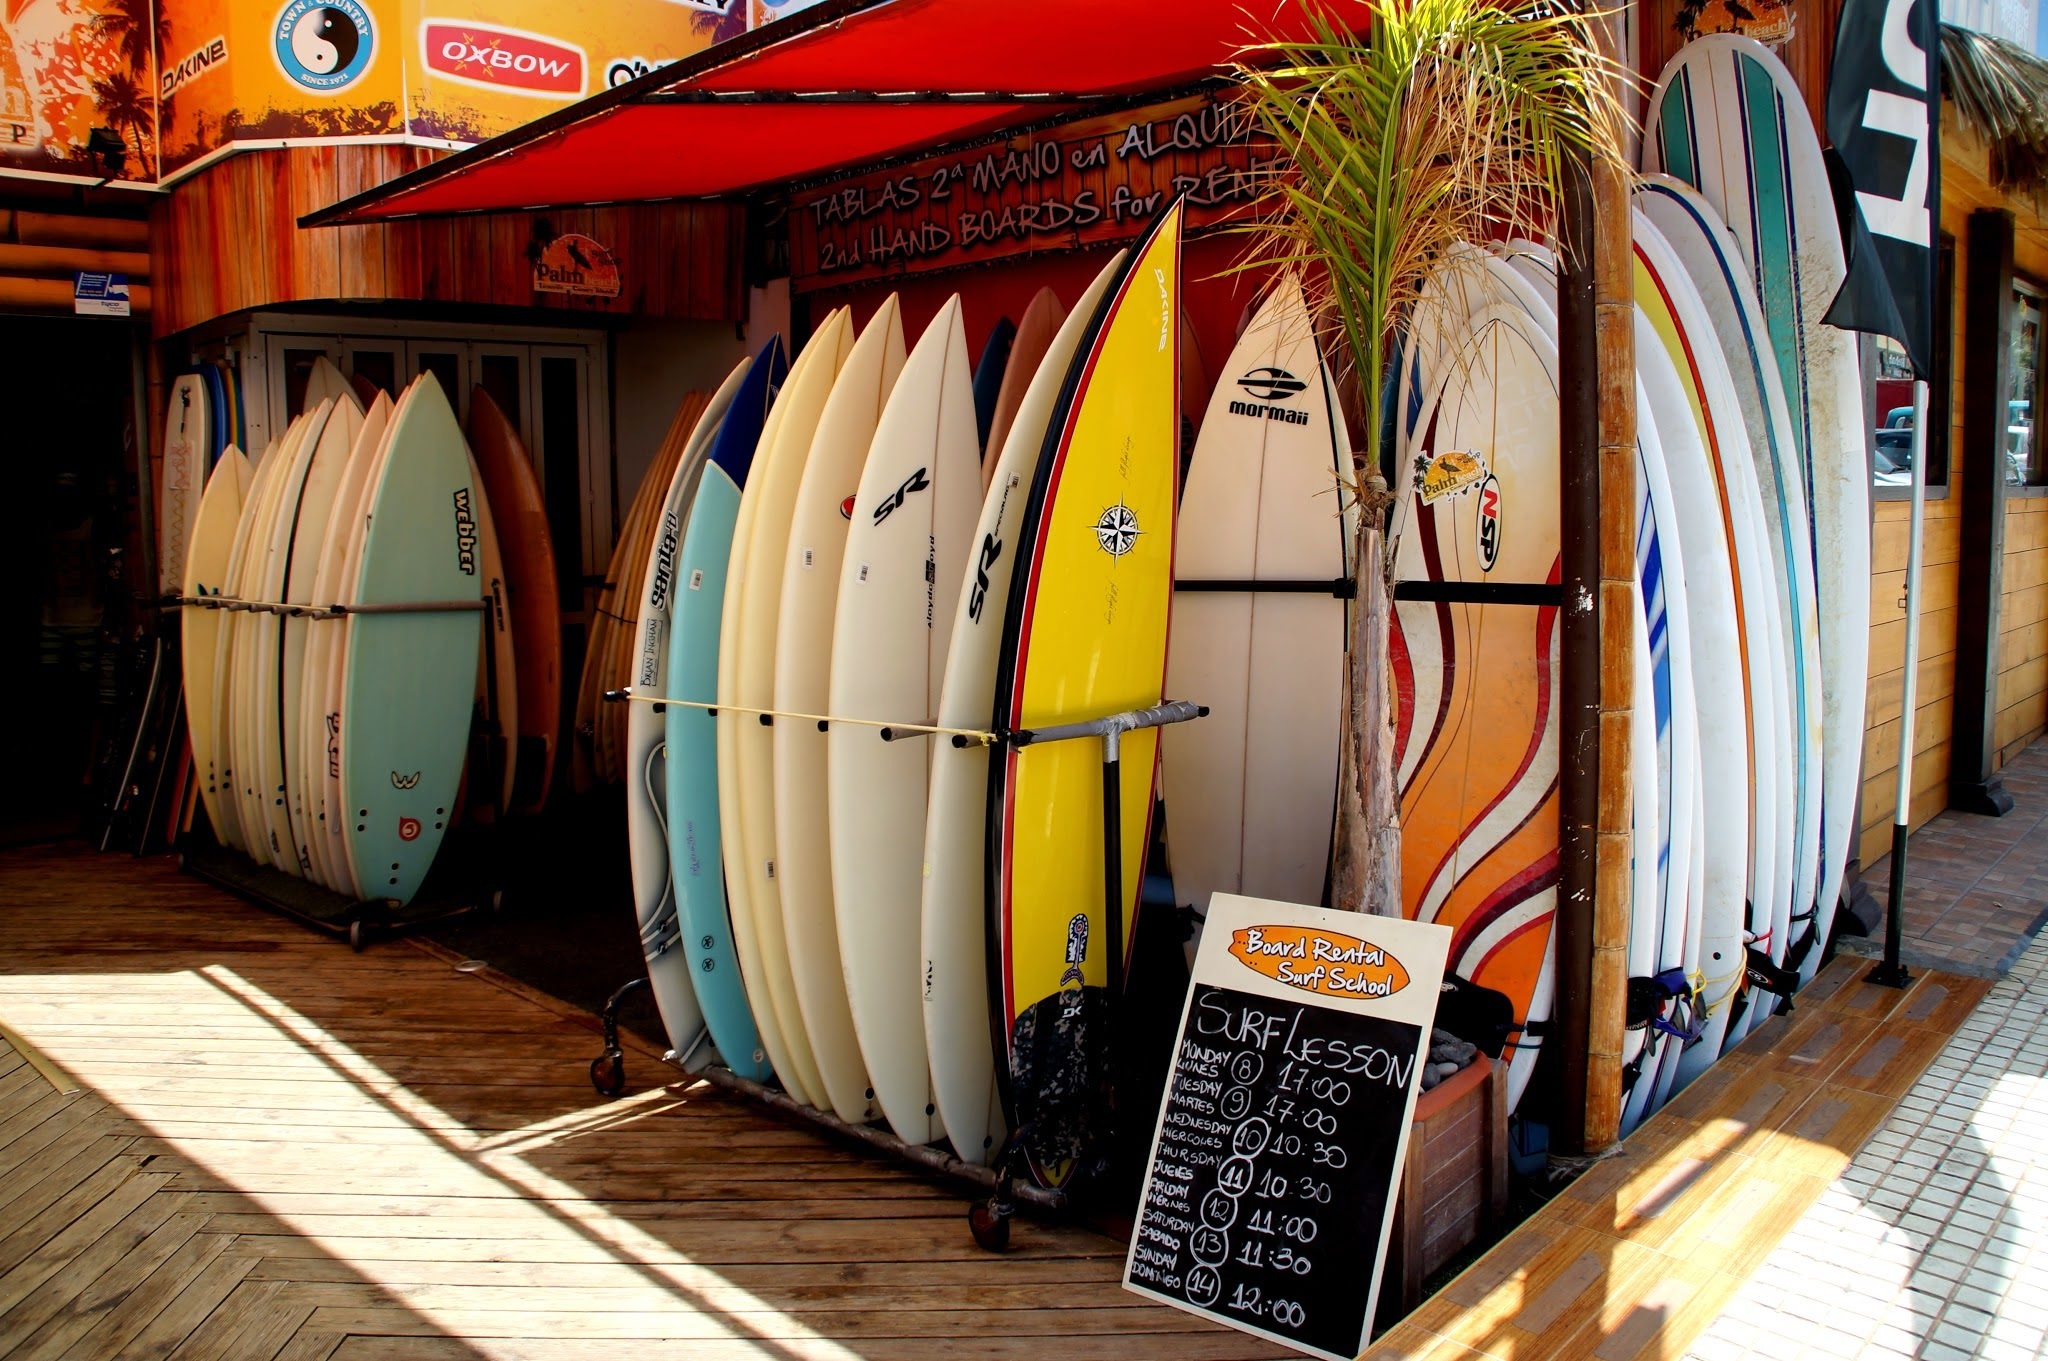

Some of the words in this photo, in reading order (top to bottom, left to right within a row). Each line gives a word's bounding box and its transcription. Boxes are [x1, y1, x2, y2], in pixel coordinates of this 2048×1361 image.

[279, 1, 307, 40] TOWN
[162, 39, 226, 95] DAKINE
[301, 73, 329, 86] SINCE
[330, 73, 349, 85] 1971
[442, 41, 571, 78] OXBOW
[809, 177, 920, 226] TABLAS
[972, 141, 1060, 193] MANO
[1071, 143, 1106, 168] en
[821, 238, 861, 270] 2nd
[869, 220, 951, 263] HAND
[958, 191, 1101, 246] BOARDS
[1111, 185, 1162, 222] for
[1154, 268, 1169, 352] DAKINE
[1229, 399, 1309, 427] mormaii
[1423, 476, 1458, 497] Palm
[453, 487, 476, 576] webber
[1480, 489, 1498, 563] NSP
[1246, 929, 1306, 958] Board
[1312, 937, 1385, 966] Rental
[1277, 961, 1325, 989] Surf
[1328, 967, 1393, 996] School
[1197, 991, 1286, 1050] SURF
[1283, 1008, 1414, 1089] LESSON
[1177, 1058, 1219, 1078] LUNES
[1182, 1039, 1231, 1067] MONDAY
[1278, 1061, 1351, 1106] 17:00
[1168, 1092, 1215, 1114] MARTES
[1172, 1073, 1224, 1100] TUESDAY
[1229, 1091, 1244, 1113] 9
[1263, 1094, 1337, 1135] 17:00
[1160, 1127, 1223, 1149] MIERCOLES
[1164, 1113, 1232, 1136] WEDNESDAY
[1234, 1127, 1262, 1150] 10
[1269, 1132, 1347, 1169] 10:30
[1153, 1159, 1194, 1181] JUEVES
[1157, 1141, 1224, 1169] THURSDAY
[1220, 1165, 1244, 1190] 11
[1145, 1191, 1191, 1213] VIERNES
[1148, 1177, 1190, 1200] FRIDAY
[1208, 1197, 1230, 1222] 12
[1247, 1209, 1317, 1244] 11:00
[1139, 1224, 1181, 1251] SABADO
[1142, 1208, 1195, 1233] SATURDAY
[1195, 1230, 1222, 1254] 13
[1235, 1241, 1312, 1276] 11:30
[1131, 1262, 1182, 1289] DOMINGO
[1134, 1244, 1178, 1271] SUNDAY
[1187, 1270, 1215, 1297] 14
[1228, 1283, 1306, 1328] 12:00
